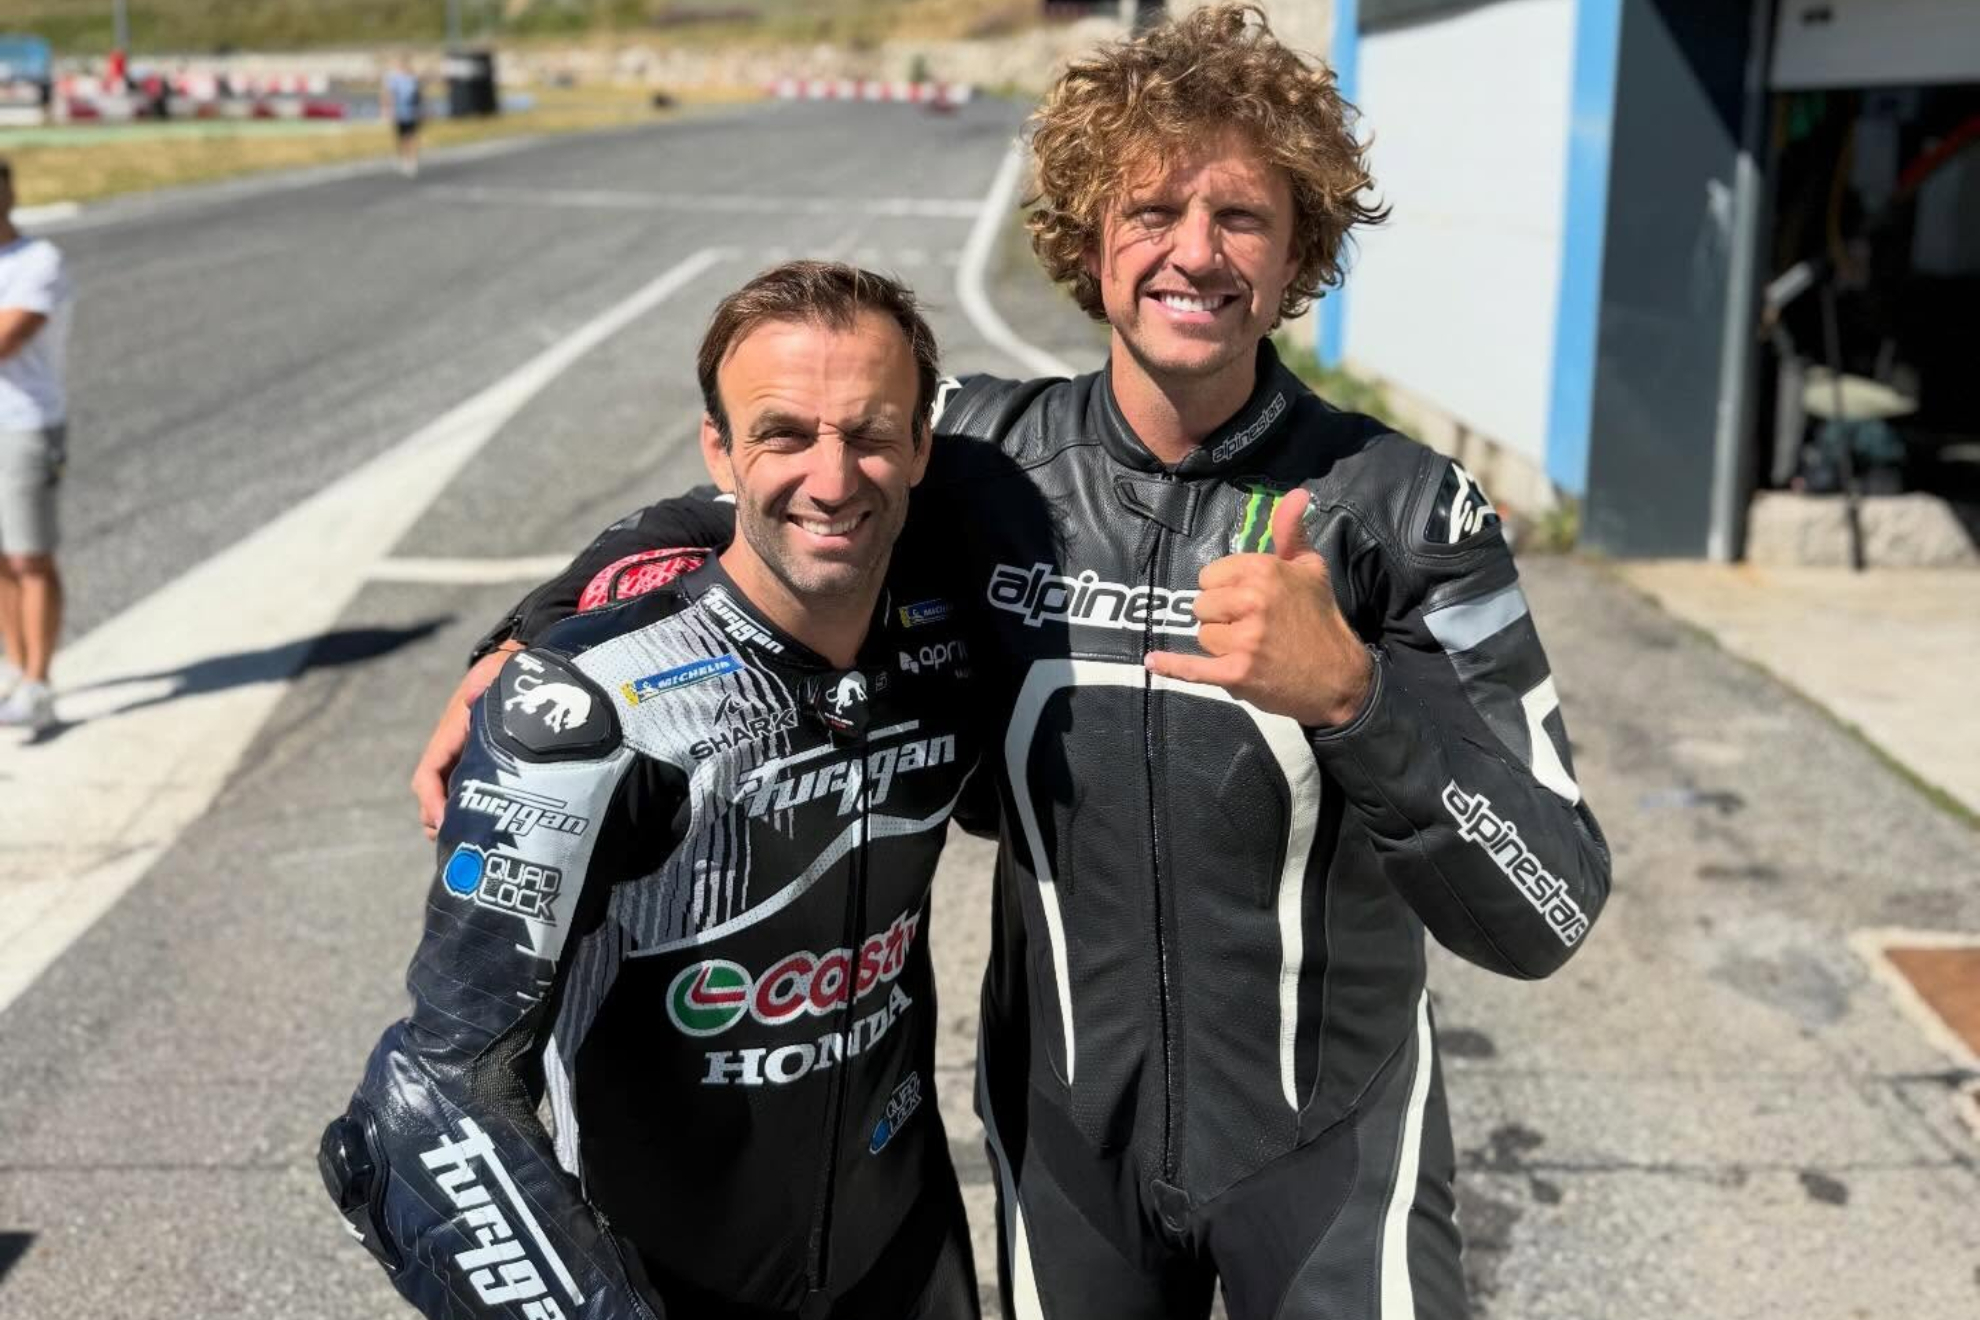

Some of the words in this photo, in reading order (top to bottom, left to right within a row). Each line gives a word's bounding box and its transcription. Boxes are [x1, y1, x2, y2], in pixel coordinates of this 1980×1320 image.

[1213, 392, 1287, 463] alpinestars
[702, 588, 785, 654] furygan
[658, 660, 732, 688] MICHELIN
[689, 709, 796, 760] SHARK
[734, 720, 955, 818] furygan
[459, 779, 589, 836] furygan
[486, 856, 560, 892] QUAD
[1442, 780, 1589, 947] alpinestars
[479, 877, 557, 919] LOCK
[701, 983, 912, 1085] HONDA
